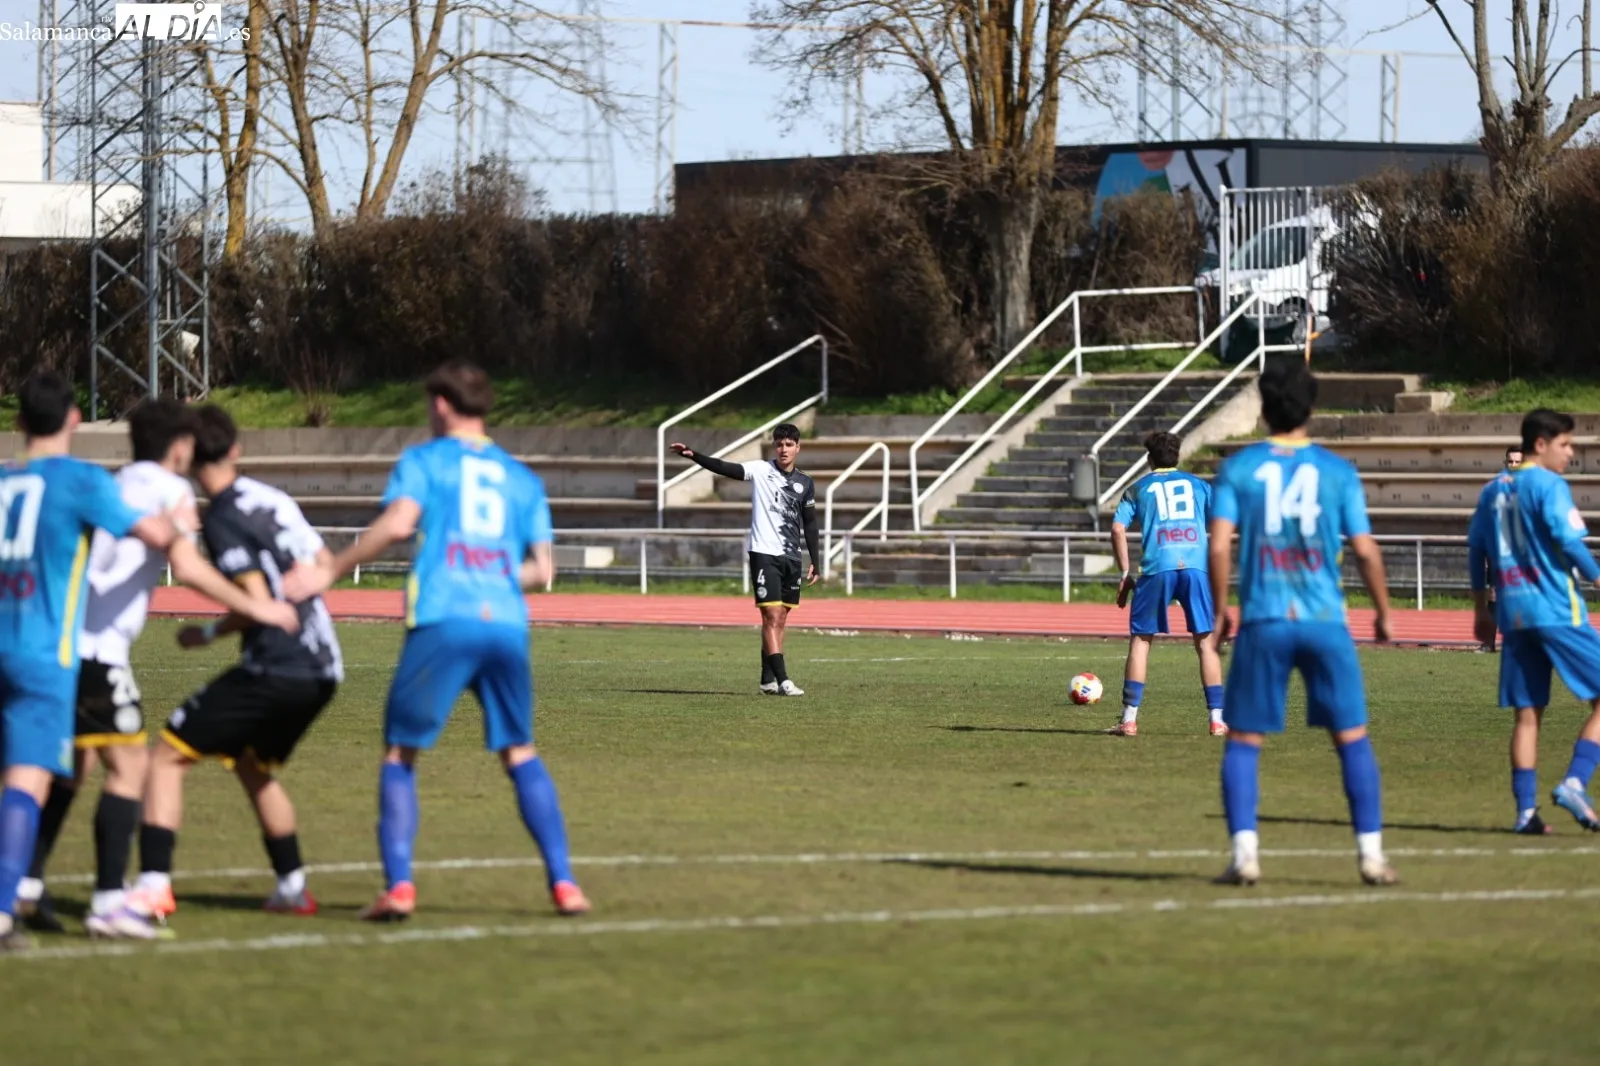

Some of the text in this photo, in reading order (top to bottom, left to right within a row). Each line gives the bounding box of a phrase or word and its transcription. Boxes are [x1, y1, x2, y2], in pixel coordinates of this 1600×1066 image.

[460, 454, 507, 539] 6
[1146, 479, 1195, 521] 18
[1253, 460, 1322, 537] 14
[1156, 526, 1198, 544] neo
[757, 568, 767, 586] 4
[1260, 544, 1323, 574] neo
